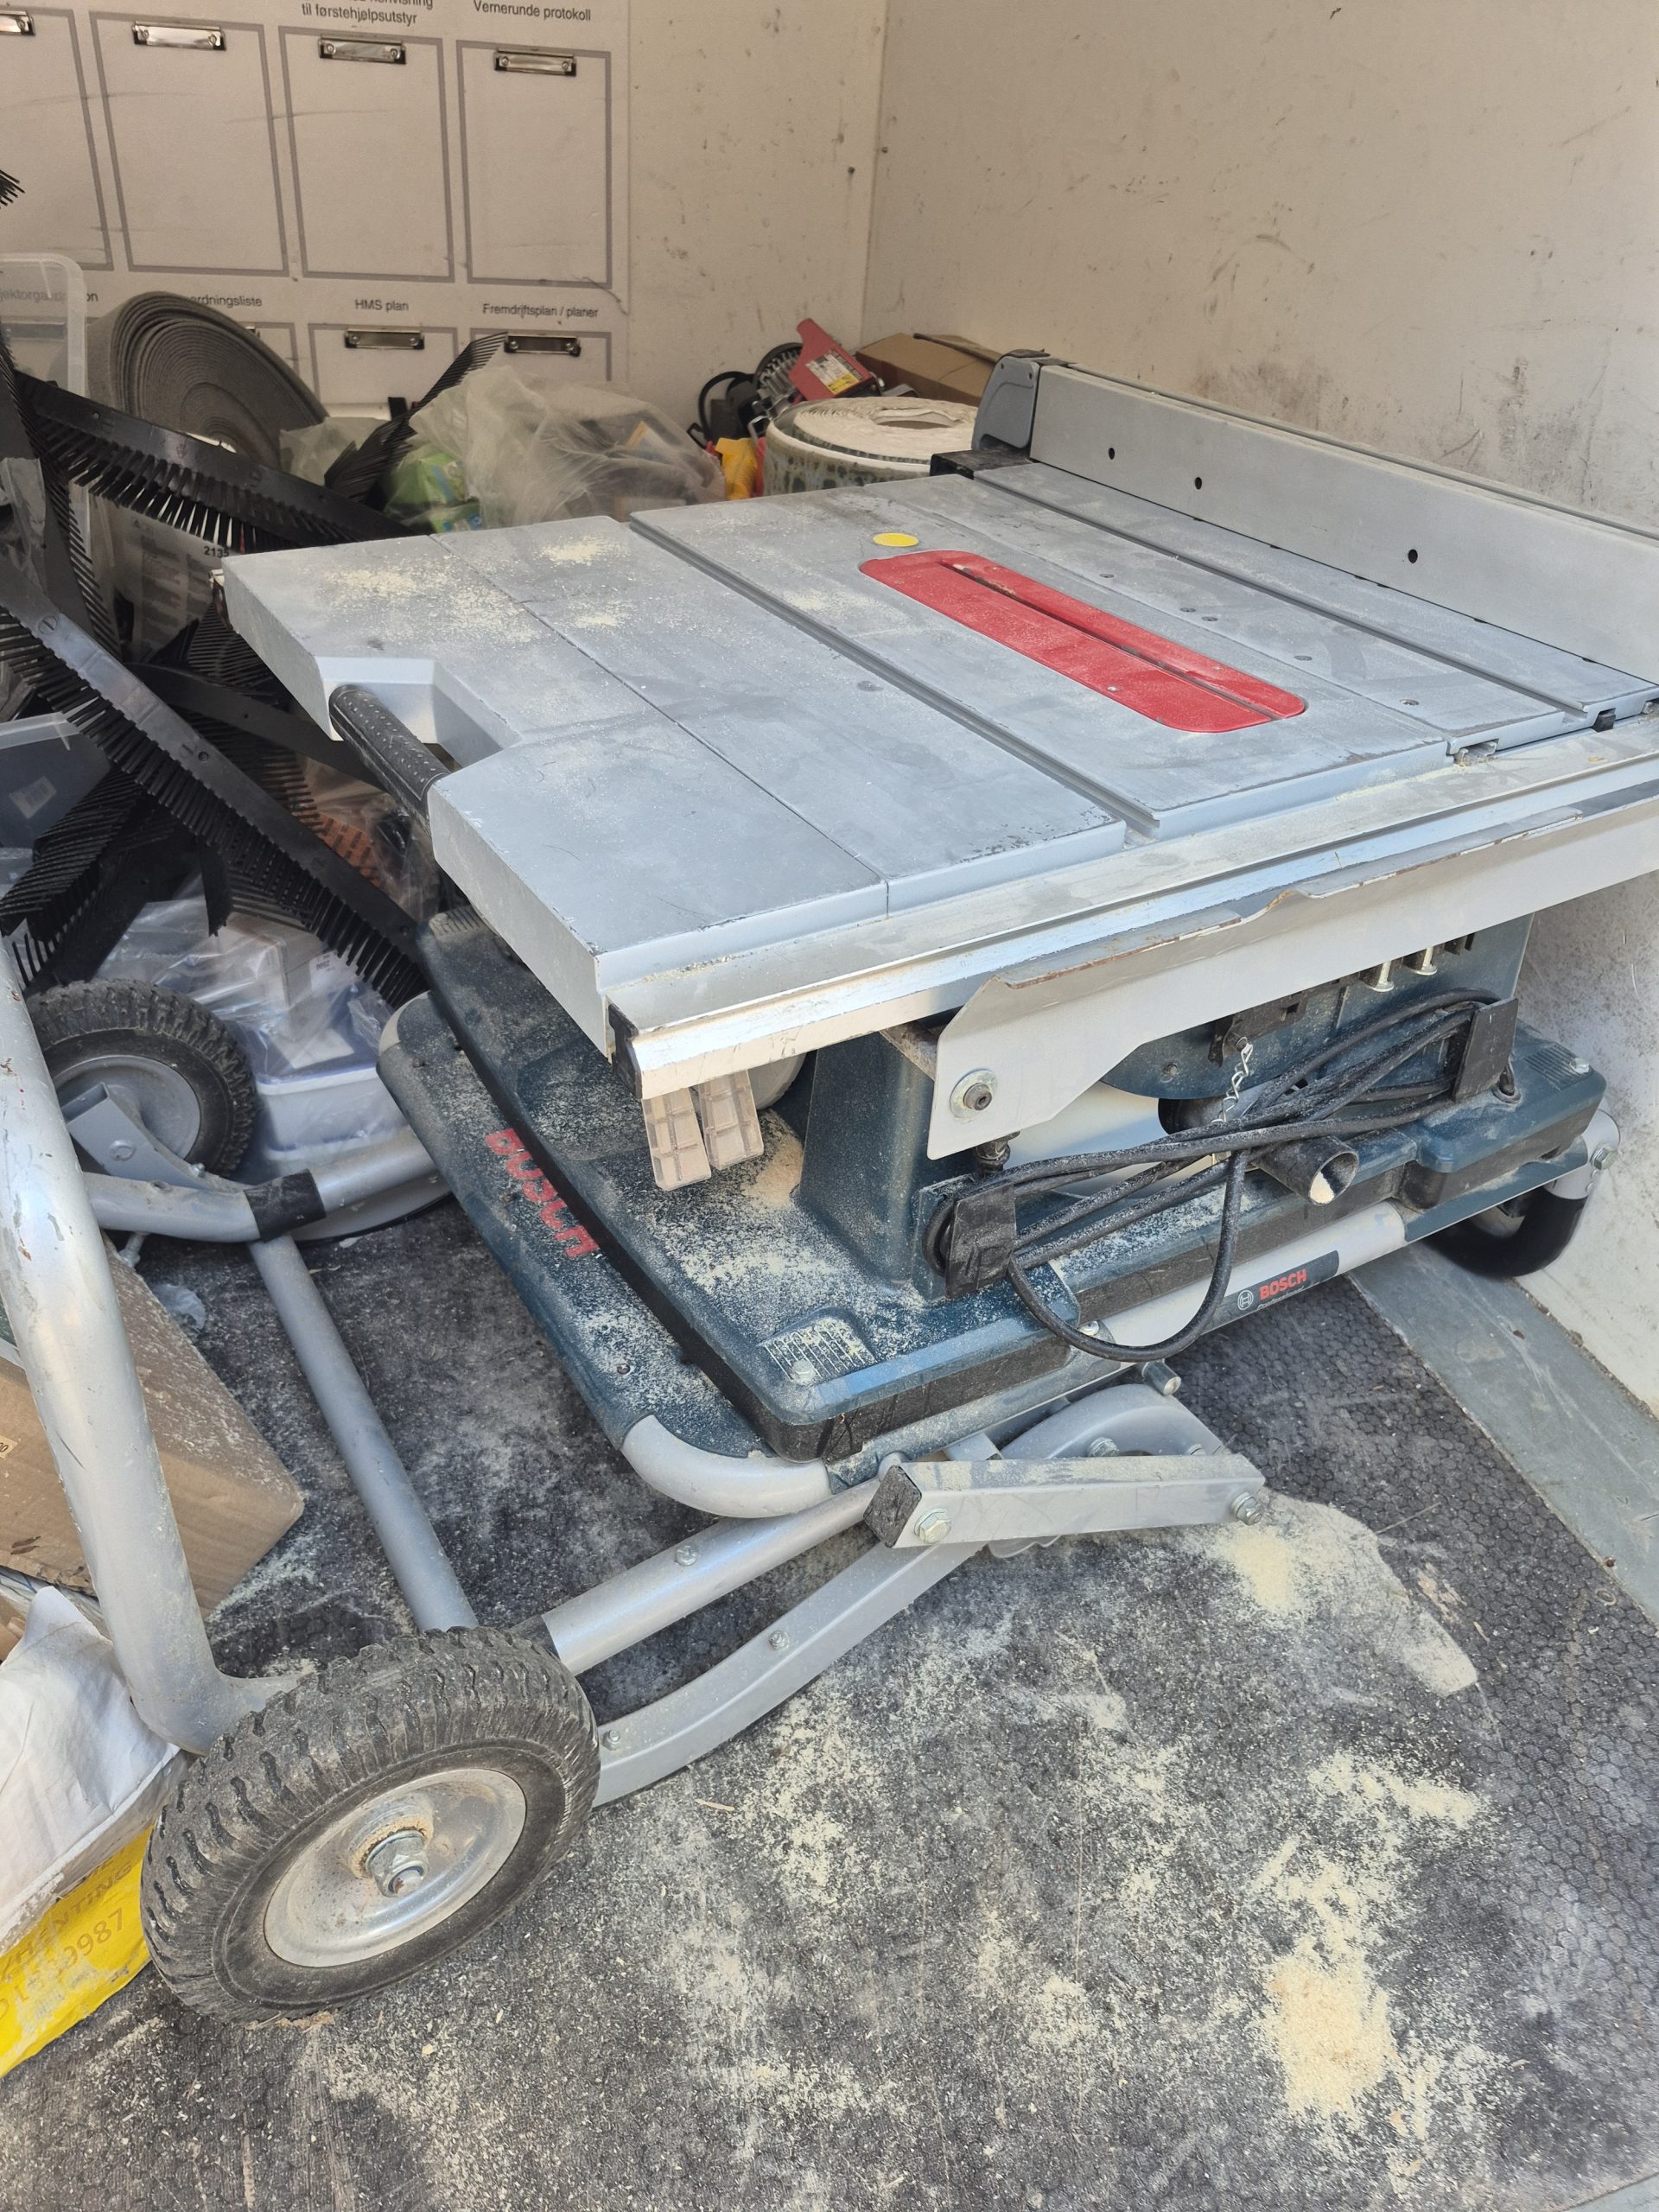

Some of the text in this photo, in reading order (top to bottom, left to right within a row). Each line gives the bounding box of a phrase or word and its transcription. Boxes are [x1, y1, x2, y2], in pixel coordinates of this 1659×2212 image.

[302, 3, 417, 27] til førstehjelpsutstyr
[474, 0, 591, 21] Vernerunde protokoll
[355, 299, 410, 313] HMS plan
[482, 303, 557, 319] Fremdriftsplan
[566, 308, 599, 319] planer
[1259, 1268, 1307, 1300] BOSCH
